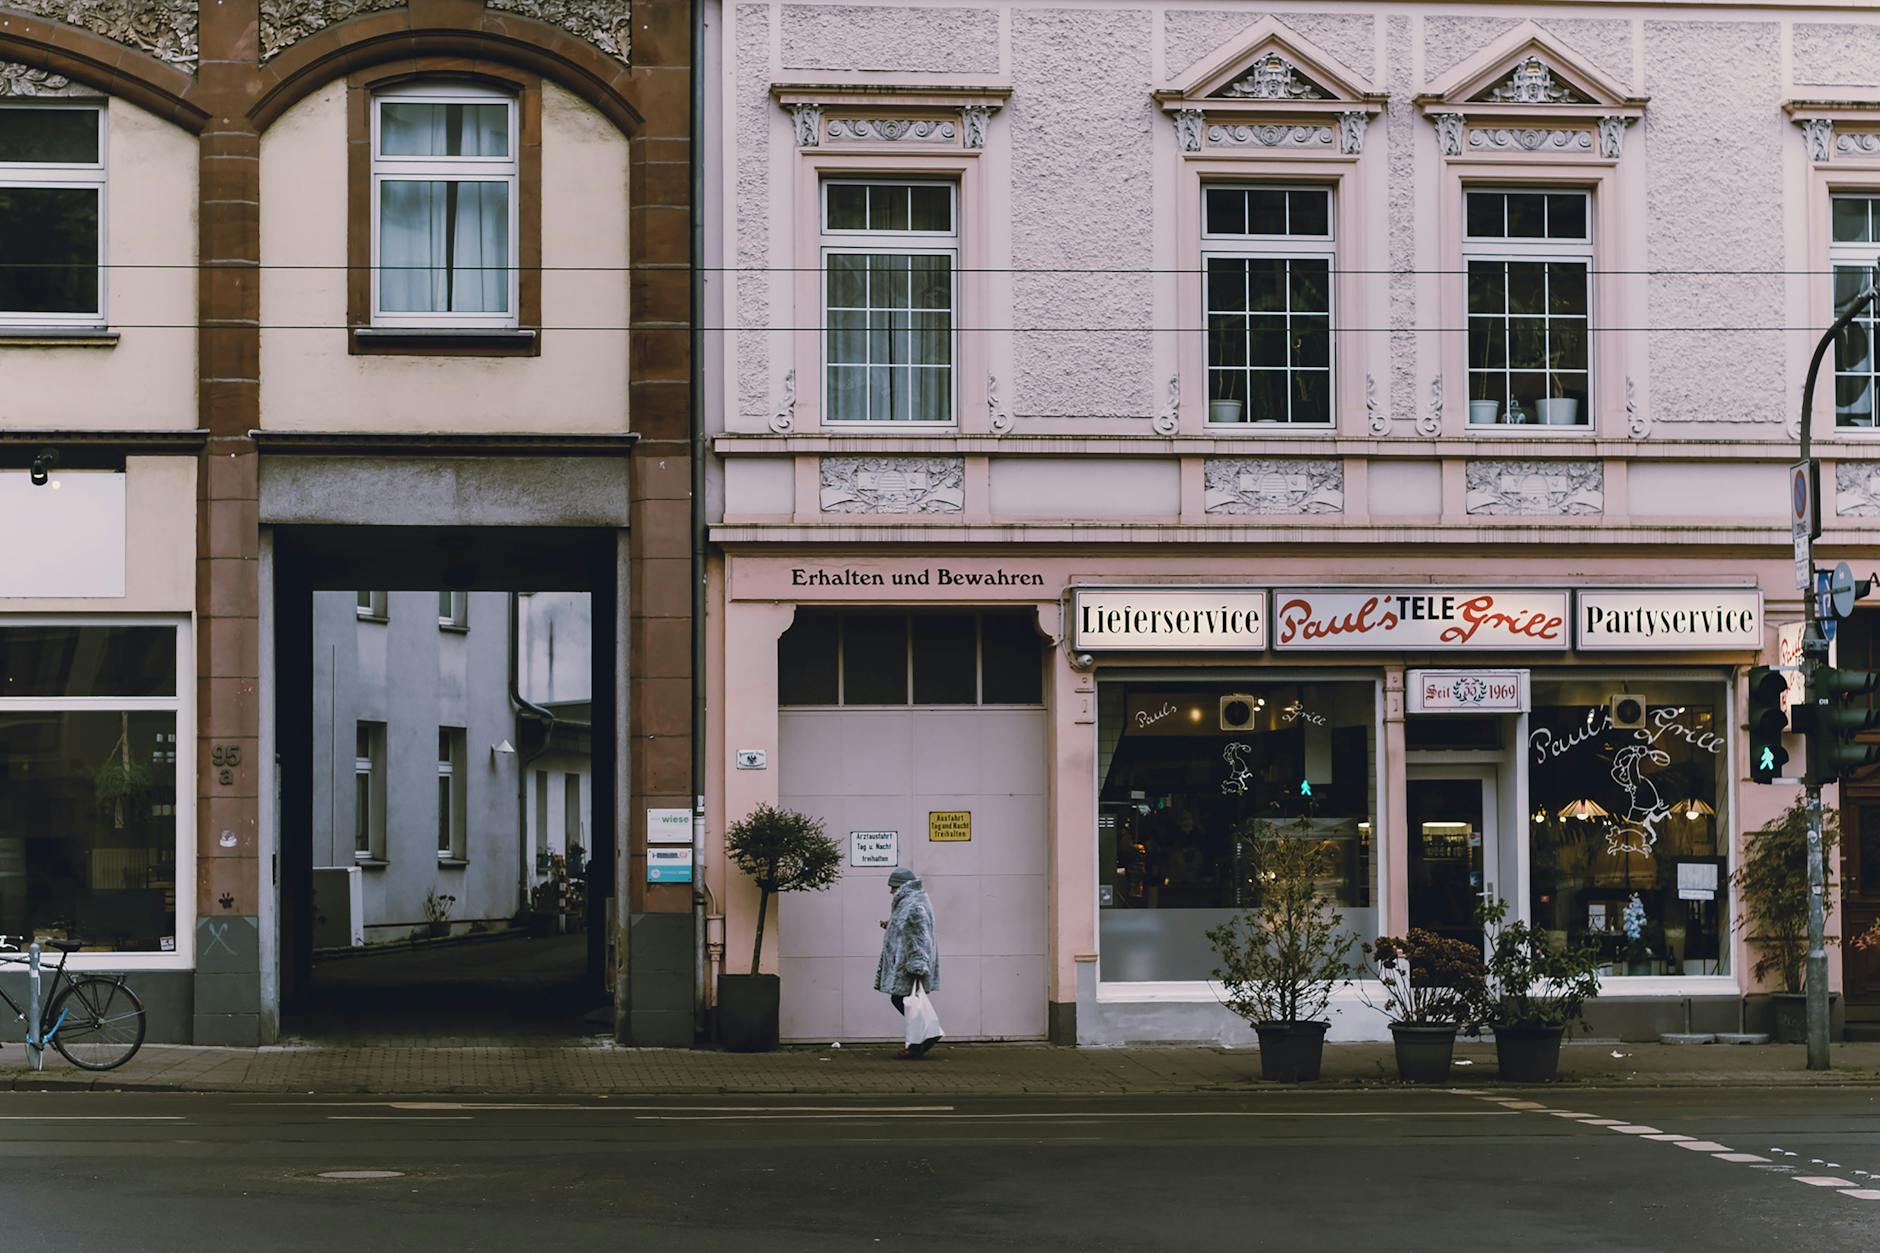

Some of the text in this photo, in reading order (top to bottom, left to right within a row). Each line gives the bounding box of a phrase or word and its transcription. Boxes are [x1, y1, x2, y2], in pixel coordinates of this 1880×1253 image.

[791, 568, 1045, 586] Erhalten und Bewahren
[1081, 605, 1260, 634] Lieferservice
[1279, 595, 1563, 644] Paul's TELE Grill
[1586, 604, 1754, 637] Partyservice
[1425, 684, 1451, 700] Seit
[1489, 684, 1516, 700] 1969
[1633, 707, 1725, 753] Grill
[211, 745, 241, 767] 95
[219, 769, 233, 786] a
[661, 814, 689, 824] wiese
[931, 822, 941, 831] Tag
[936, 814, 964, 822] Ausfahrt
[857, 843, 867, 852] Tag
